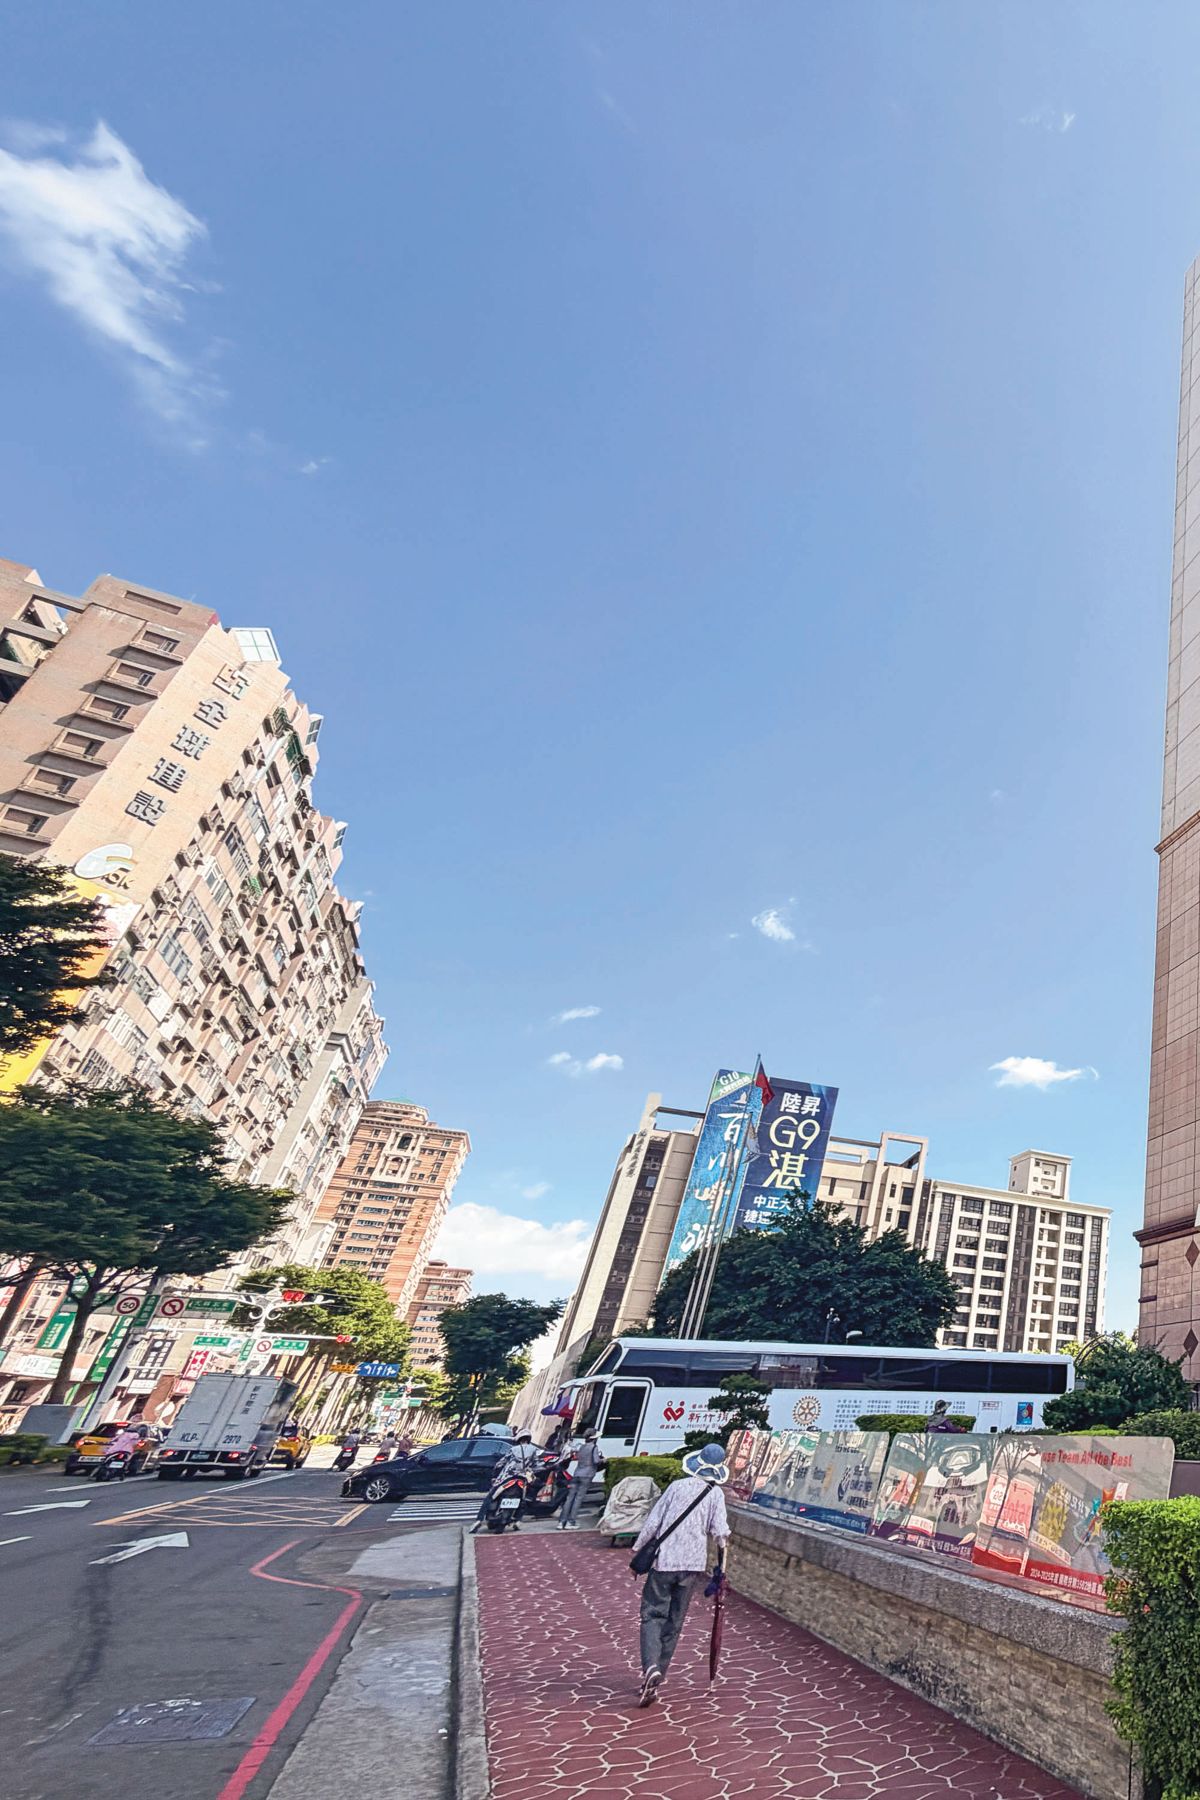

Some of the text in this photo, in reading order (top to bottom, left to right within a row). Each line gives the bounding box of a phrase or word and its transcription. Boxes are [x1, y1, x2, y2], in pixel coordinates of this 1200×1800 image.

[719, 1071, 740, 1086] G10
[779, 1092, 822, 1117] 陸昇
[769, 1115, 821, 1151] G9
[762, 1149, 810, 1191] 湛
[121, 1301, 136, 1310] 50
[1111, 1451, 1133, 1468] Best
